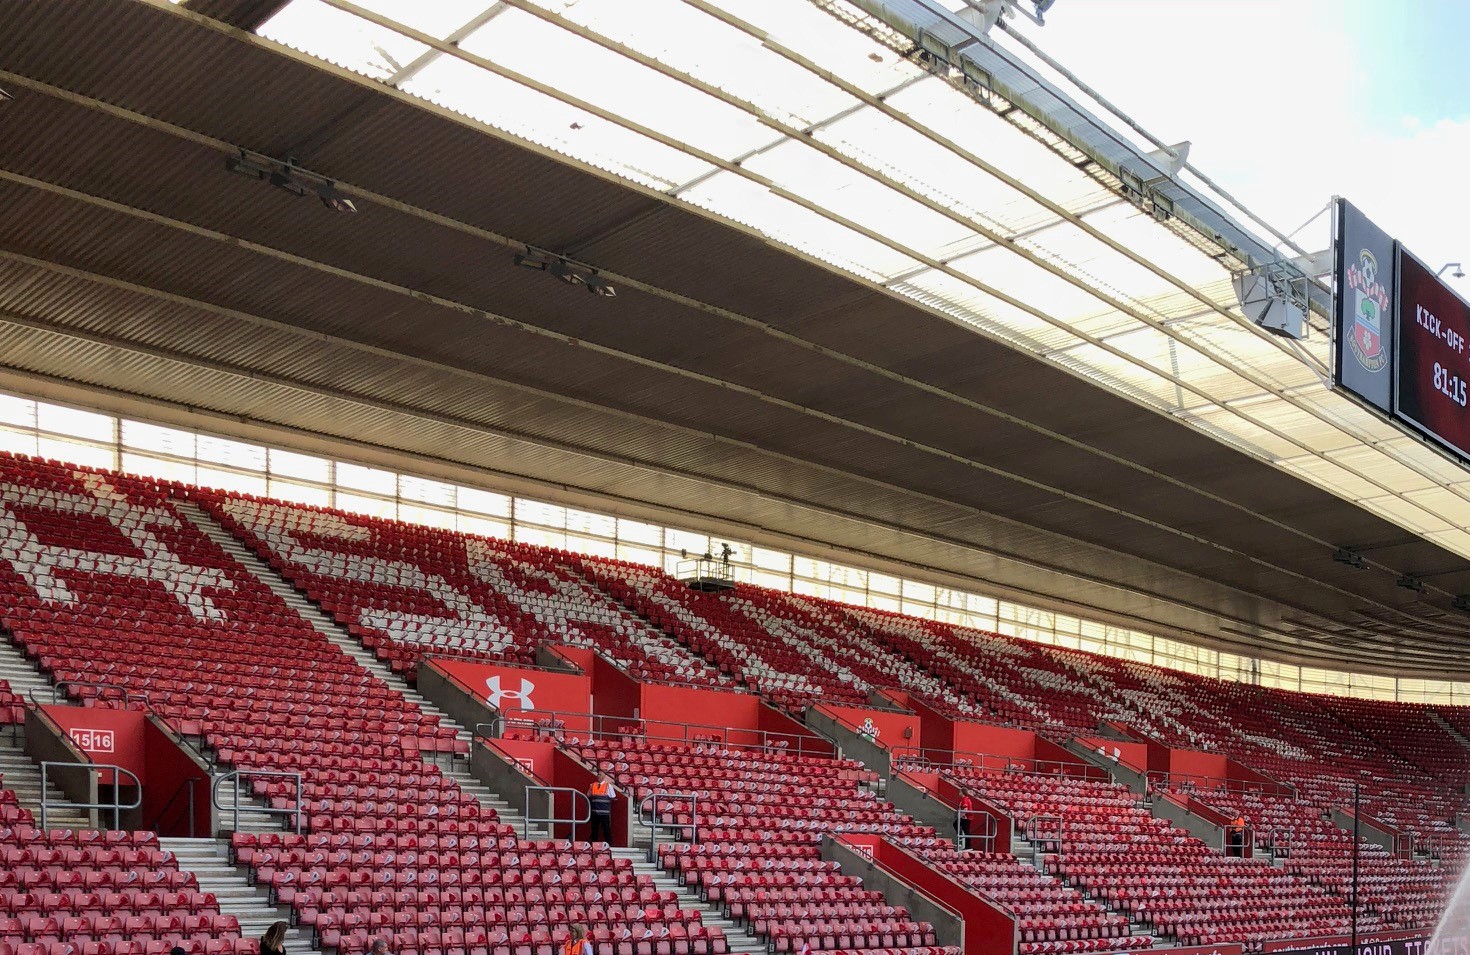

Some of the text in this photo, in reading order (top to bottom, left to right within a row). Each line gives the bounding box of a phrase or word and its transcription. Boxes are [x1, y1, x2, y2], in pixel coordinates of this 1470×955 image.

[1416, 303, 1465, 355] KICK-OFF
[1433, 362, 1467, 407] 81:15
[73, 732, 111, 748] 15 16
